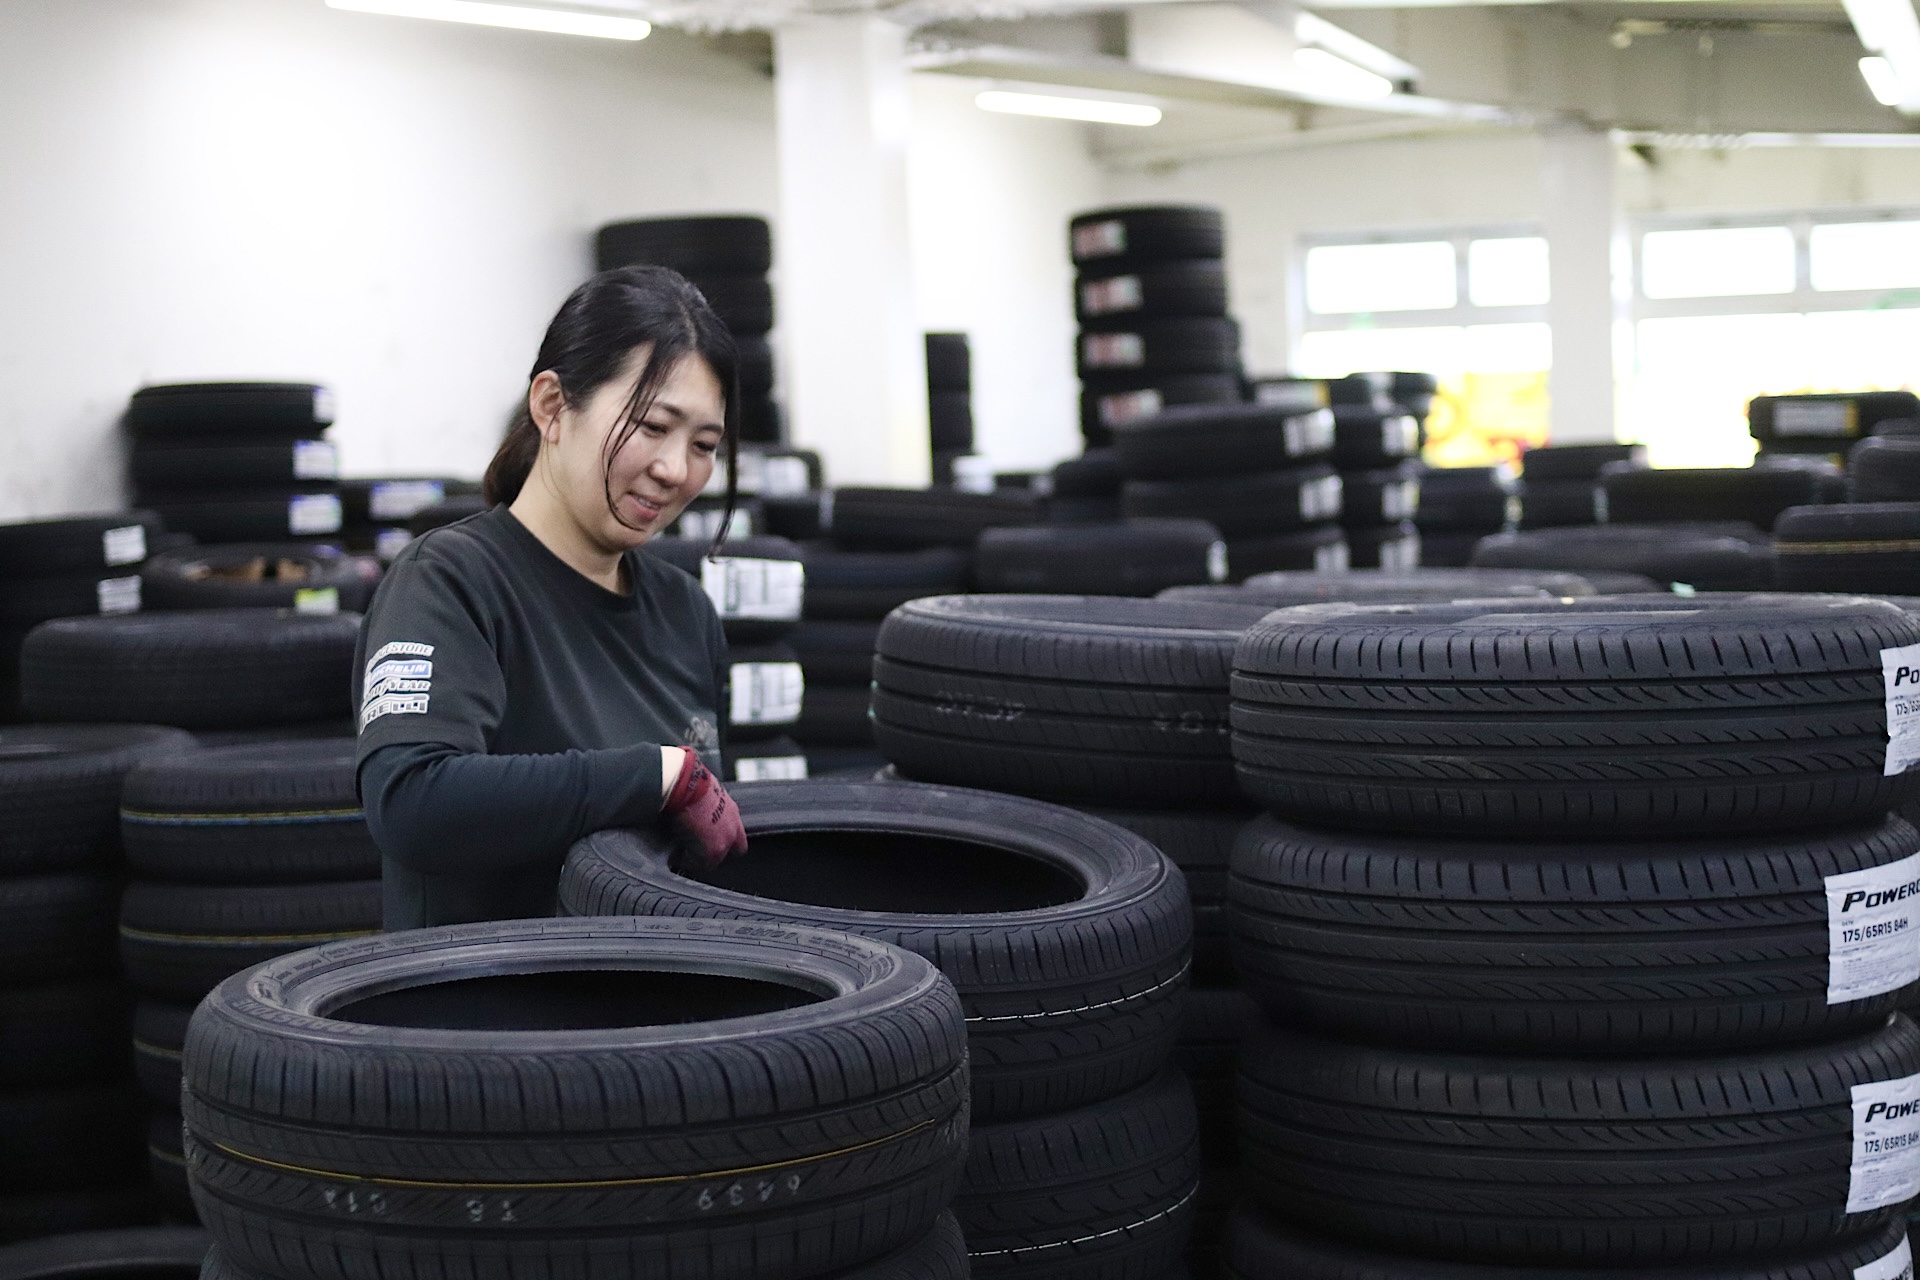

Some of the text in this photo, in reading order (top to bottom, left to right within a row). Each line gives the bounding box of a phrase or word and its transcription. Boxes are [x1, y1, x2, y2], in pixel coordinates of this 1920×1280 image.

[367, 642, 432, 672] DGESTONE
[1843, 921, 1892, 943] 175/65R15
[1865, 1134, 1906, 1153] 175/65R15
